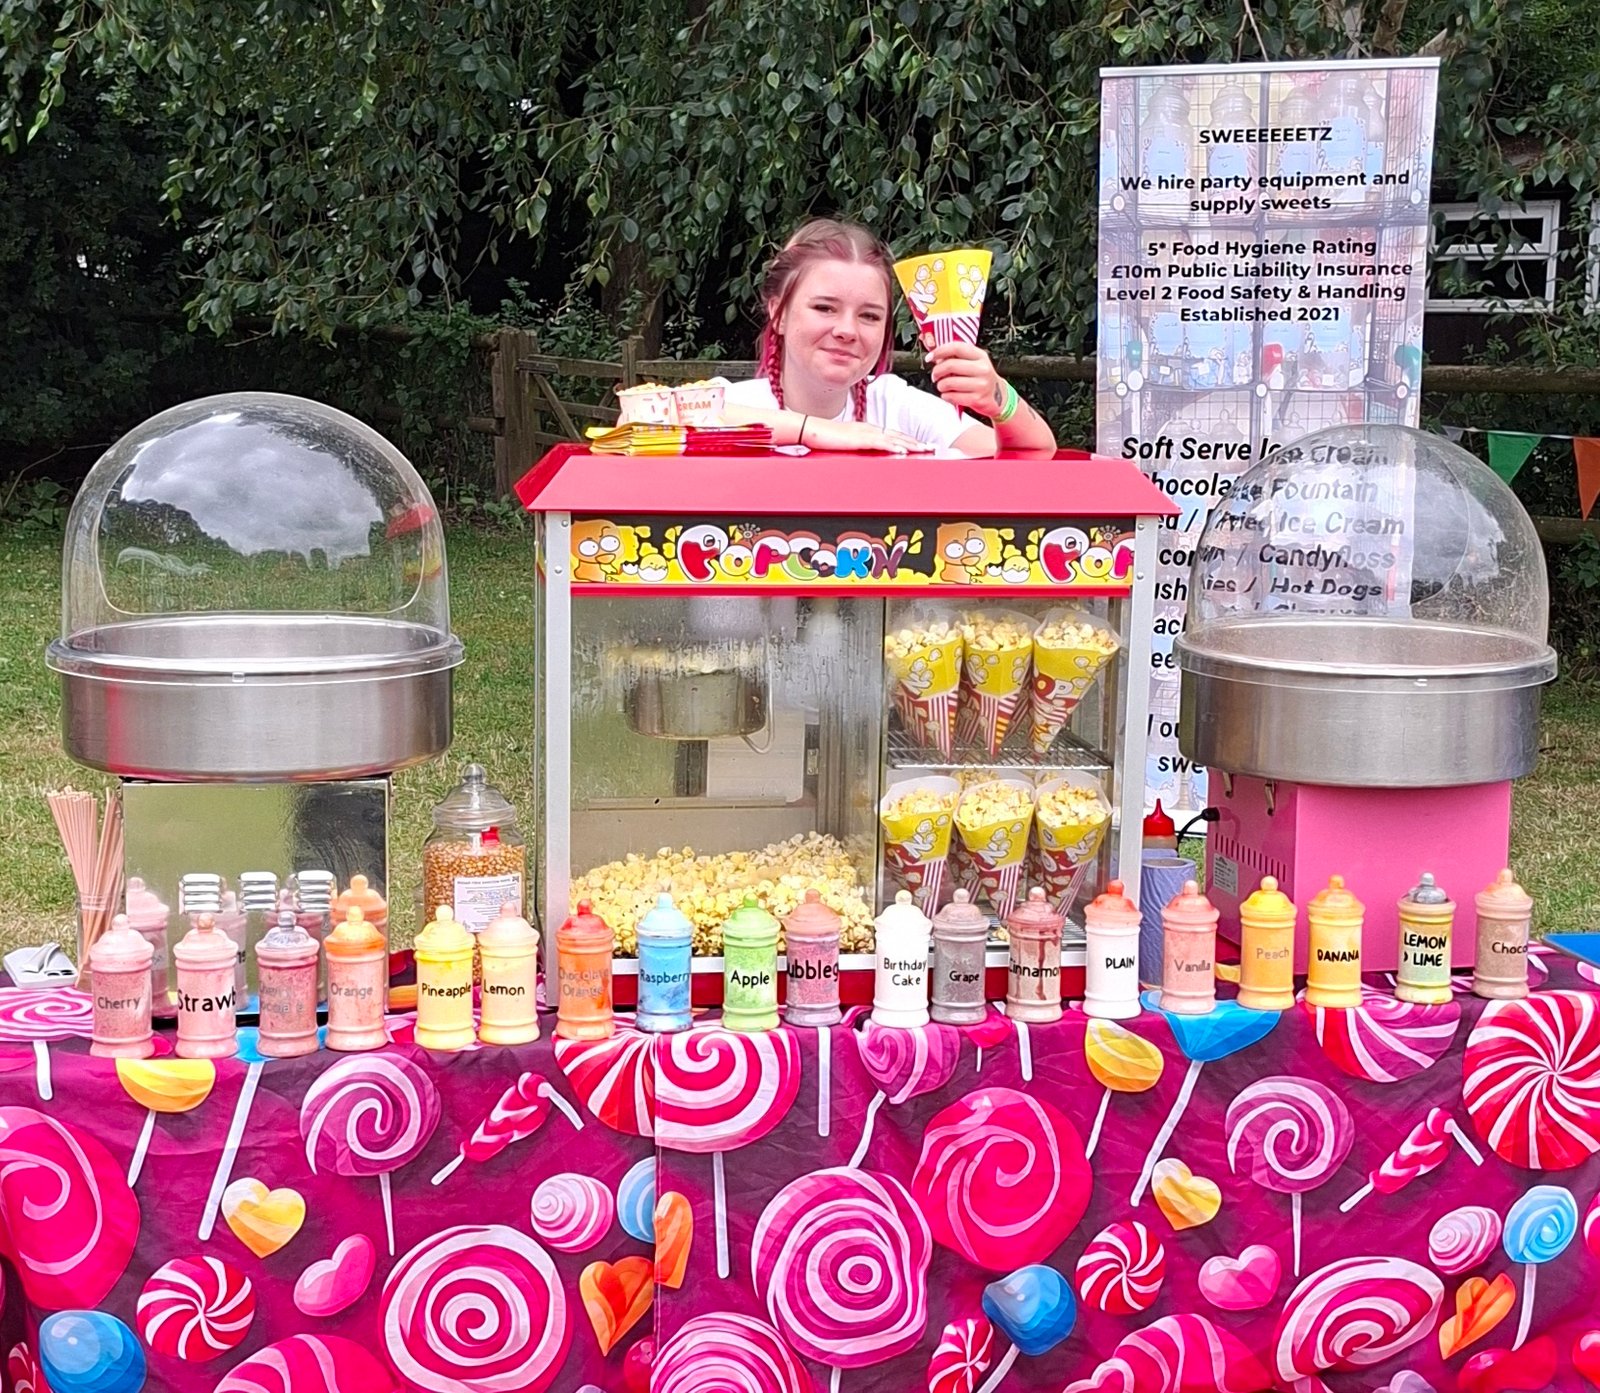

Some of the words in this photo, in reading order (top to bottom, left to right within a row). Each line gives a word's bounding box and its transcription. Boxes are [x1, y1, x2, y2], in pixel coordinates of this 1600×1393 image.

[1199, 127, 1333, 144] SWEEEEEETZ
[1120, 176, 1152, 191] We
[1158, 174, 1196, 190] hire
[1201, 175, 1253, 192] party
[1258, 171, 1367, 191] equipment
[1372, 169, 1410, 186] and
[1190, 196, 1256, 215] supply
[1261, 196, 1332, 210] sweets
[1172, 241, 1219, 256] Food
[1225, 239, 1306, 258] Hygiene
[1312, 238, 1377, 257] Rating
[1111, 265, 1162, 279] £10m
[1168, 262, 1228, 278] Public
[1233, 261, 1311, 280] Liability
[1317, 262, 1413, 277] Insurance
[1106, 286, 1156, 301] Level
[1161, 286, 1172, 300] 2
[1177, 285, 1225, 300] Food
[1230, 284, 1292, 303] Safety
[1297, 285, 1311, 299] &
[1317, 282, 1406, 302] Handling
[1180, 306, 1292, 322] Established
[1297, 307, 1340, 321] 2021
[1121, 436, 1174, 460] Soft
[1179, 437, 1252, 461] Serve
[1270, 475, 1379, 502] Fountain
[1279, 511, 1318, 534] Ice
[1325, 511, 1406, 535] Cream
[1269, 577, 1316, 594] Hot
[1320, 577, 1383, 601] Dogs
[1404, 931, 1447, 950] LEMON
[1256, 946, 1290, 960] Peach
[1316, 948, 1360, 963] BANANA
[1413, 952, 1444, 967] LIME
[883, 957, 927, 973] Birthday
[1105, 955, 1136, 970] PLAIN
[1173, 959, 1212, 973] Vanilla
[730, 969, 771, 989] Apple
[892, 974, 921, 986] Cake
[949, 970, 980, 983] Grape
[330, 982, 374, 1000] Orange
[483, 978, 526, 997] Lemon
[97, 996, 142, 1010] Cherry
